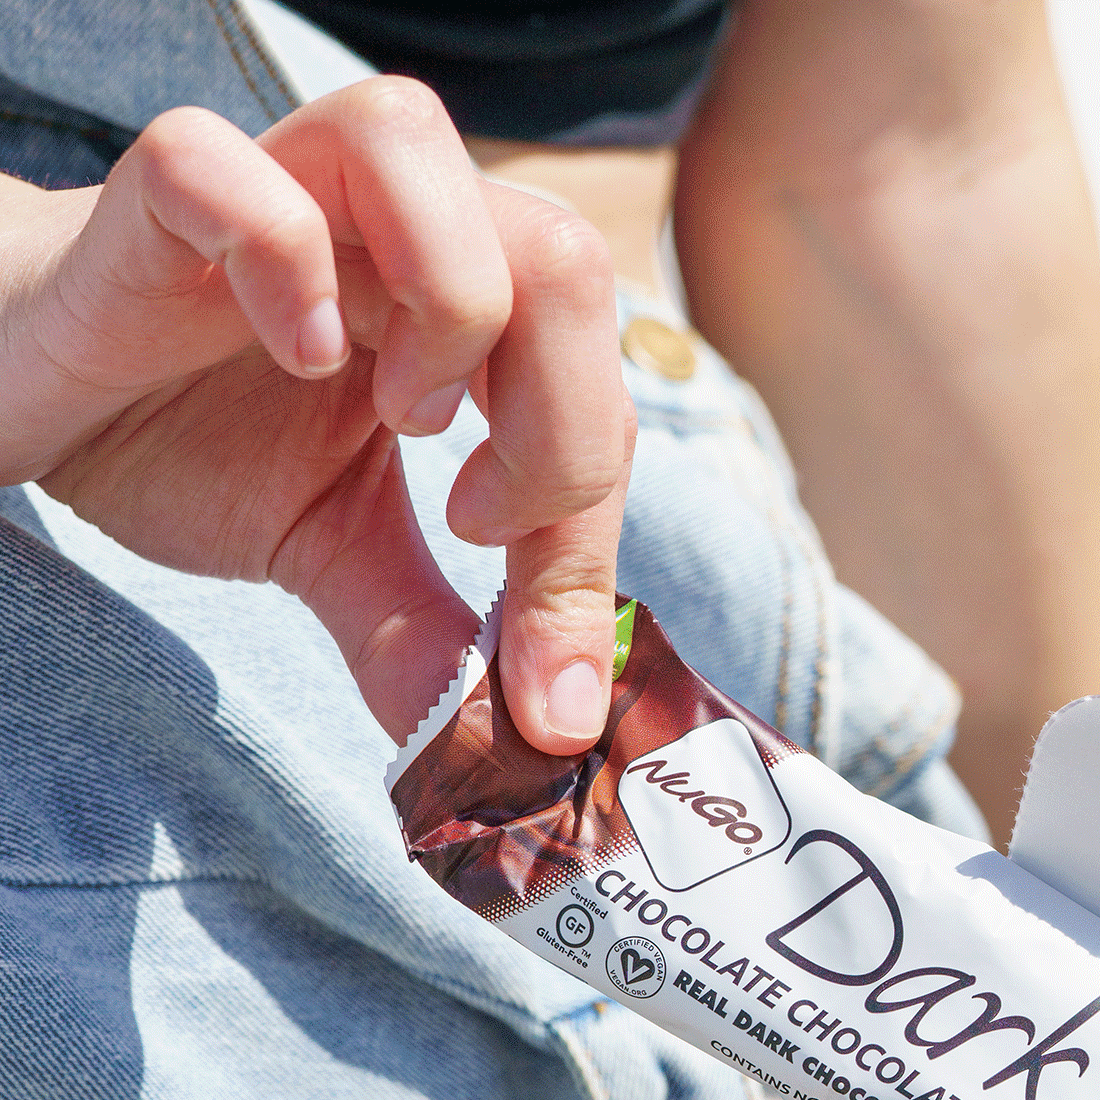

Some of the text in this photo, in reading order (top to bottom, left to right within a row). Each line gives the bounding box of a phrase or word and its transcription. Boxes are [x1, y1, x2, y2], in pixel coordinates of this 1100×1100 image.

[626, 759, 763, 845] NuGo
[570, 886, 609, 920] Certified
[536, 926, 589, 969] Gluten-Free
[565, 916, 586, 937] GF
[595, 870, 792, 1009] CHOCOLATE
[613, 939, 664, 982] CERTIFIED VEGAN
[609, 969, 647, 996] VEGAN.ORG
[672, 969, 729, 1019] REAL
[732, 1009, 801, 1064] DARK
[710, 1040, 792, 1095] CONTAINS
